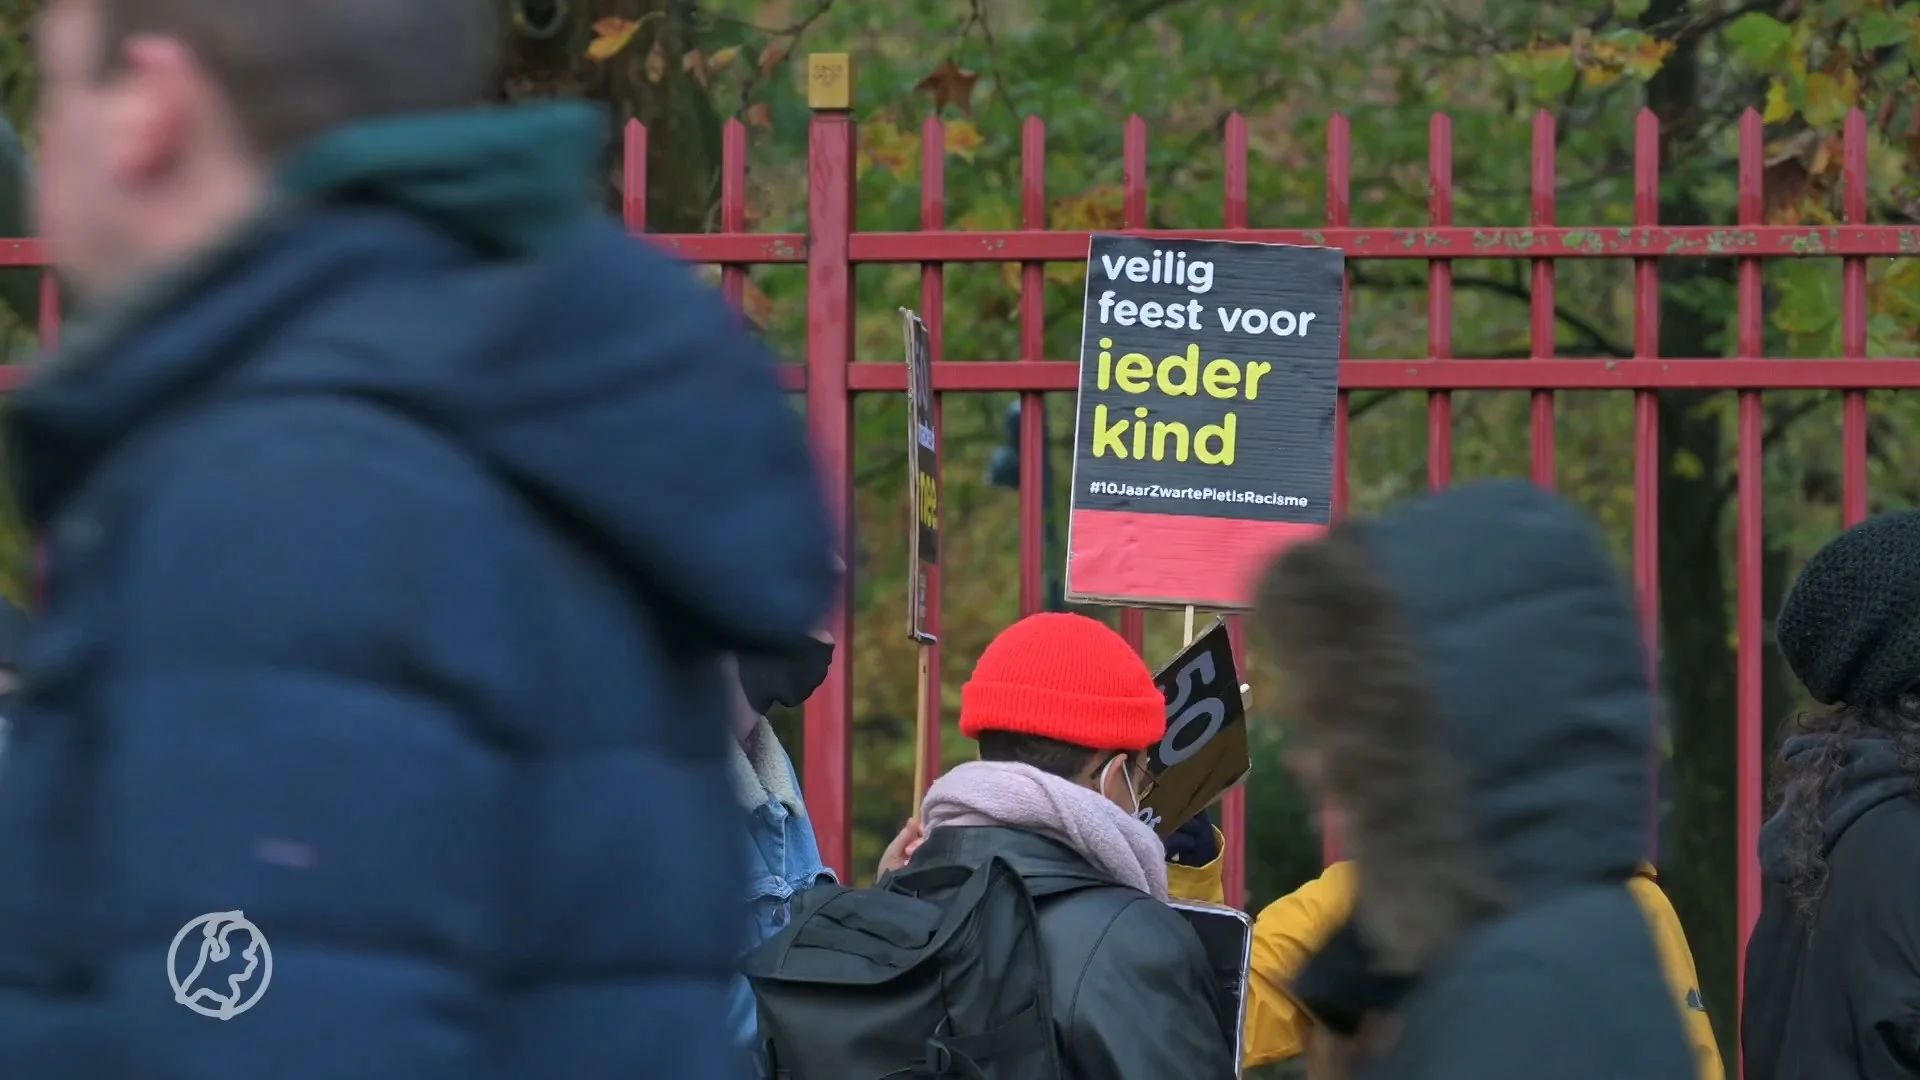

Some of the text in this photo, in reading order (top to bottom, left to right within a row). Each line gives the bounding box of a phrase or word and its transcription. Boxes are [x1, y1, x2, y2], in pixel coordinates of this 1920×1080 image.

[1101, 249, 1214, 294] veilig
[1098, 290, 1316, 337] feest voor
[1096, 337, 1272, 400] ieder
[1092, 404, 1237, 465] kind
